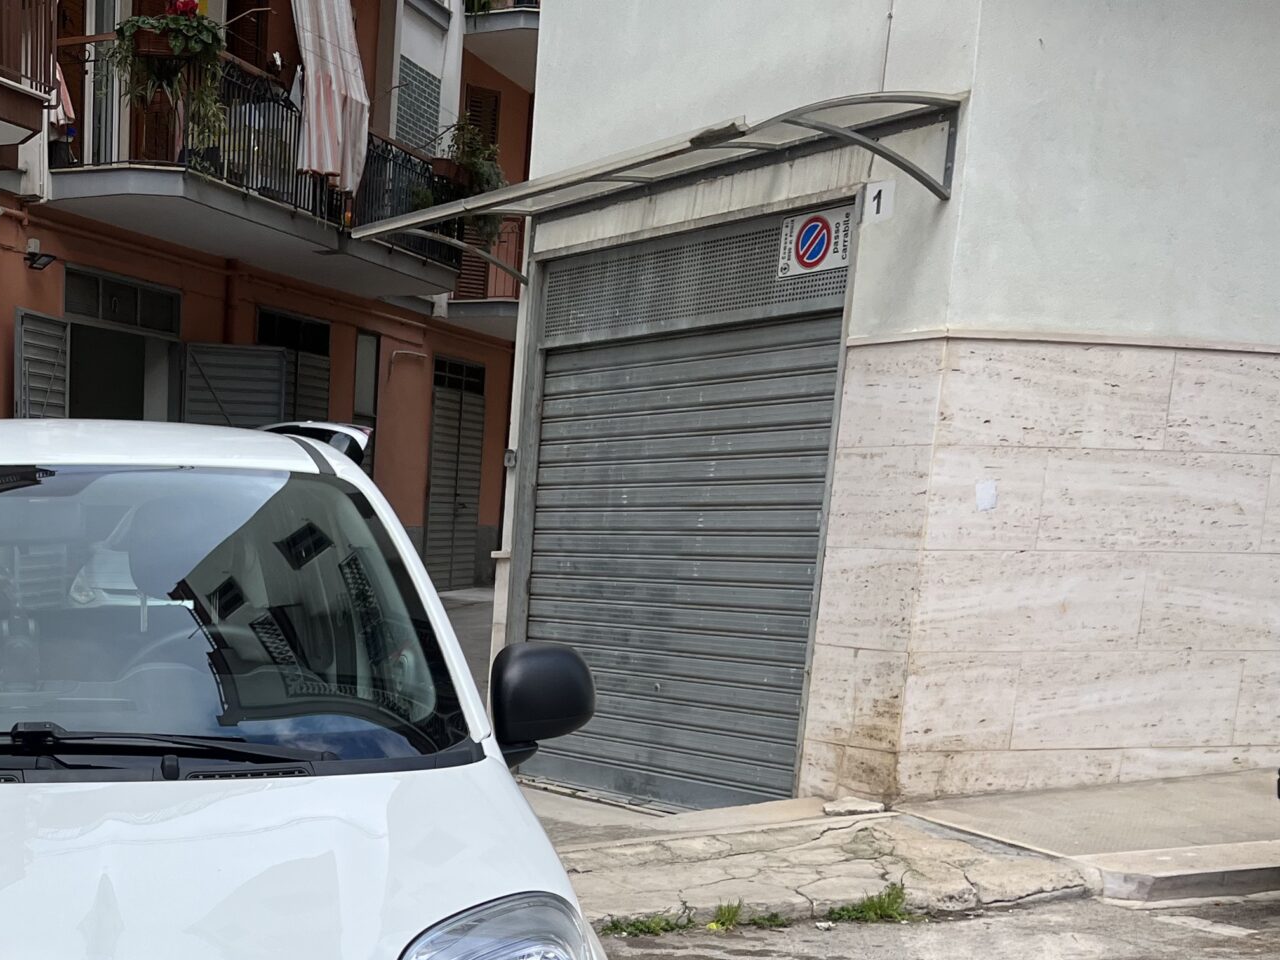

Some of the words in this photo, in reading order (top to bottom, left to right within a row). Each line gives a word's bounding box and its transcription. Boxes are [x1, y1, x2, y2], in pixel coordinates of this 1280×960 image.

[872, 188, 883, 215] 1
[832, 222, 840, 254] passo
[841, 212, 851, 260] carrabile
